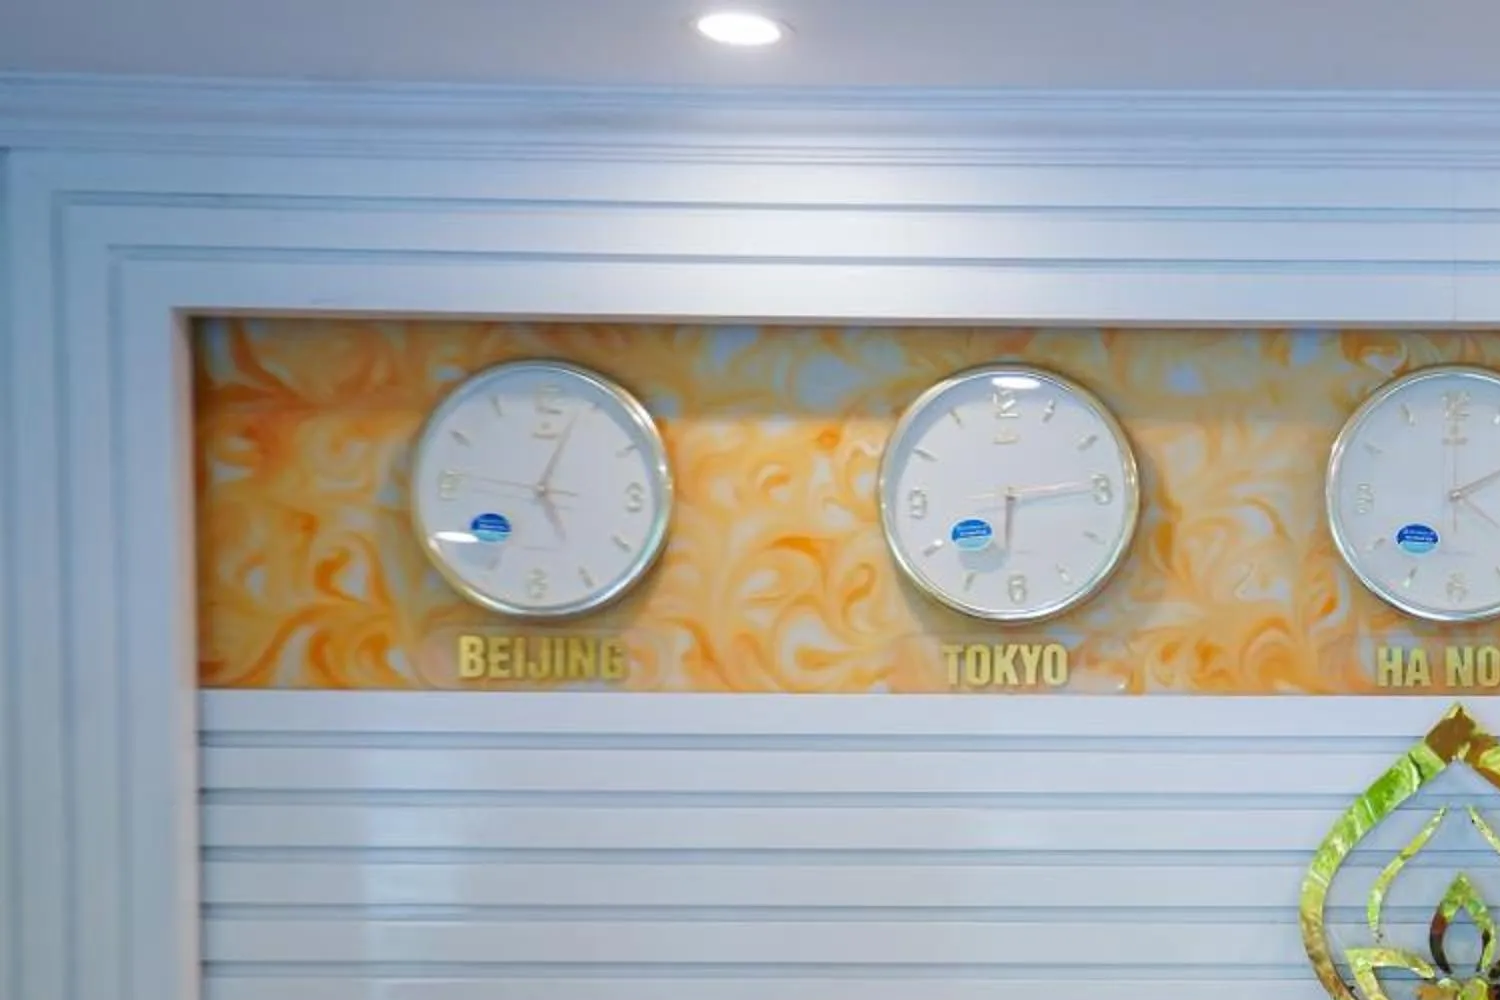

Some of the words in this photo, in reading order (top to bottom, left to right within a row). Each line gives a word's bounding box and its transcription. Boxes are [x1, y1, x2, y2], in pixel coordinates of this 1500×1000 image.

[992, 390, 1020, 418] 12
[1090, 474, 1112, 505] 3
[1008, 574, 1026, 604] 6
[459, 635, 626, 679] BEIJING
[942, 643, 1069, 685] TOKYO
[1377, 646, 1431, 687] HA
